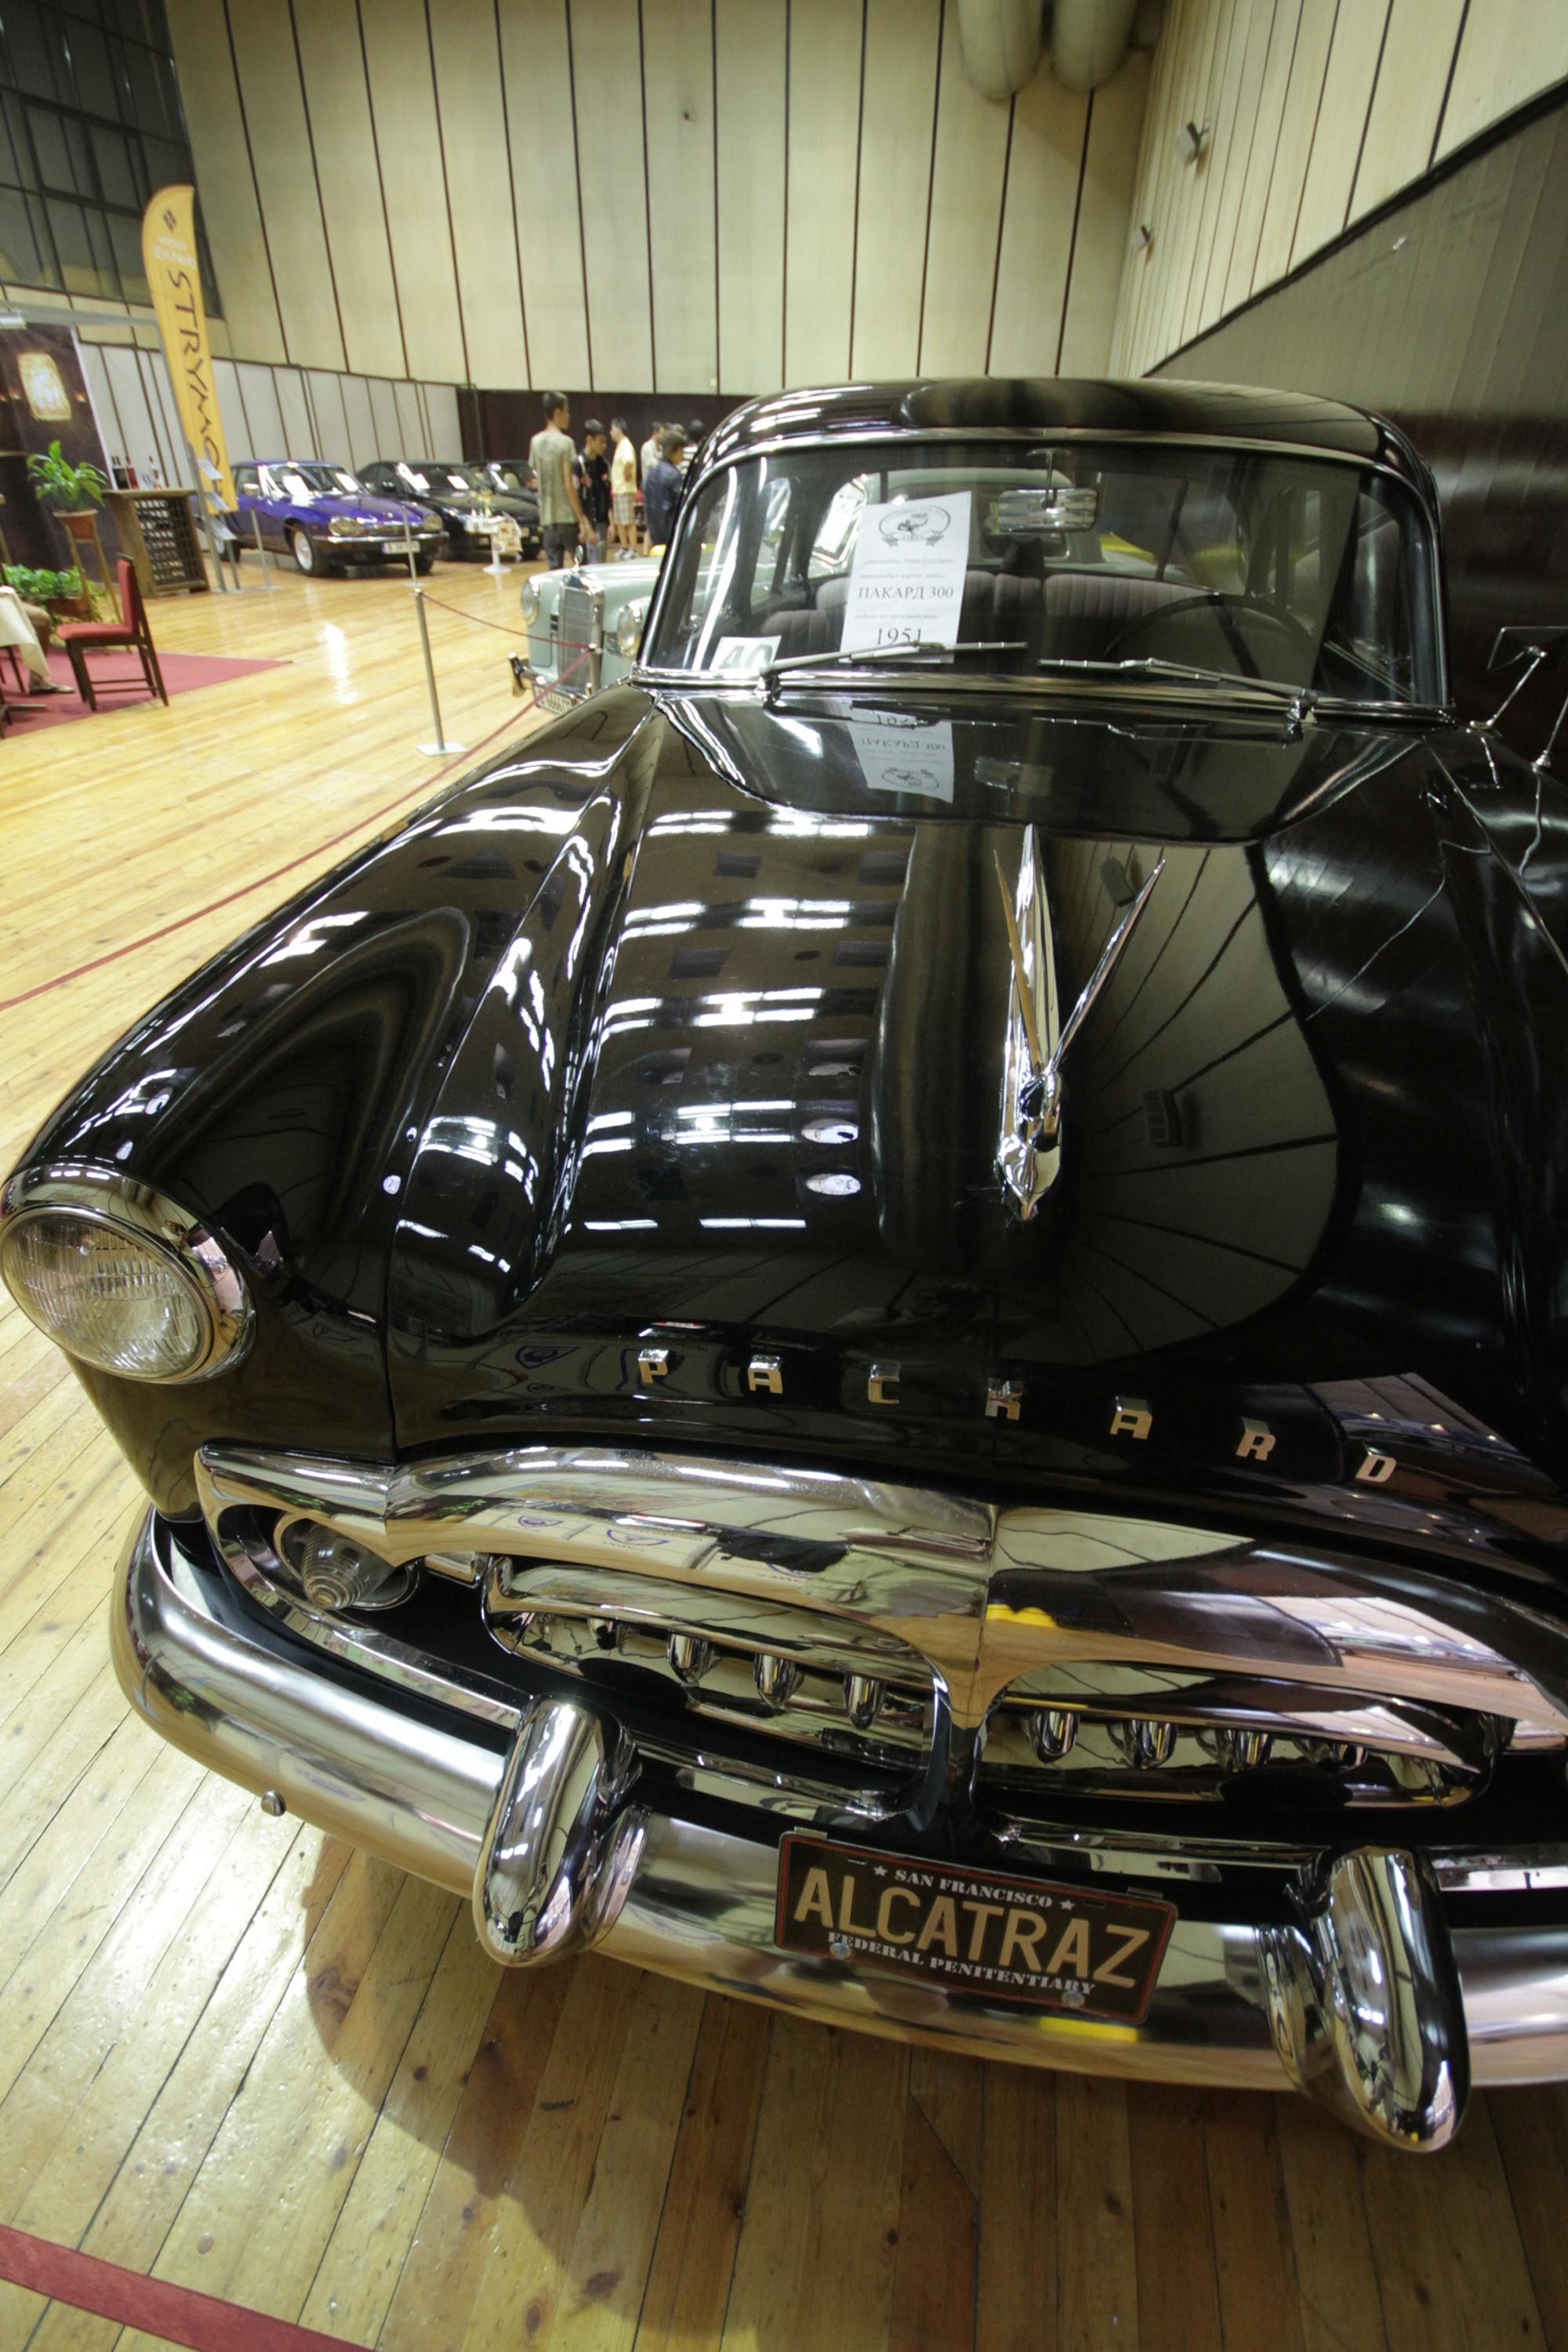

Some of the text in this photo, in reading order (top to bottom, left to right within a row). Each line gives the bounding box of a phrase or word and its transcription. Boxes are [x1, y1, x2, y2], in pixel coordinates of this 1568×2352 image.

[166, 268, 229, 506] STRYMO
[858, 586, 954, 601] ПАКАРД 300
[638, 1348, 1397, 1483] PACKARD
[793, 1866, 1151, 1989] ALCATRAZ
[894, 1868, 1054, 1908] SAN FRANCISCO
[828, 1931, 1096, 1995] FEDERAL PENITENTIARY
